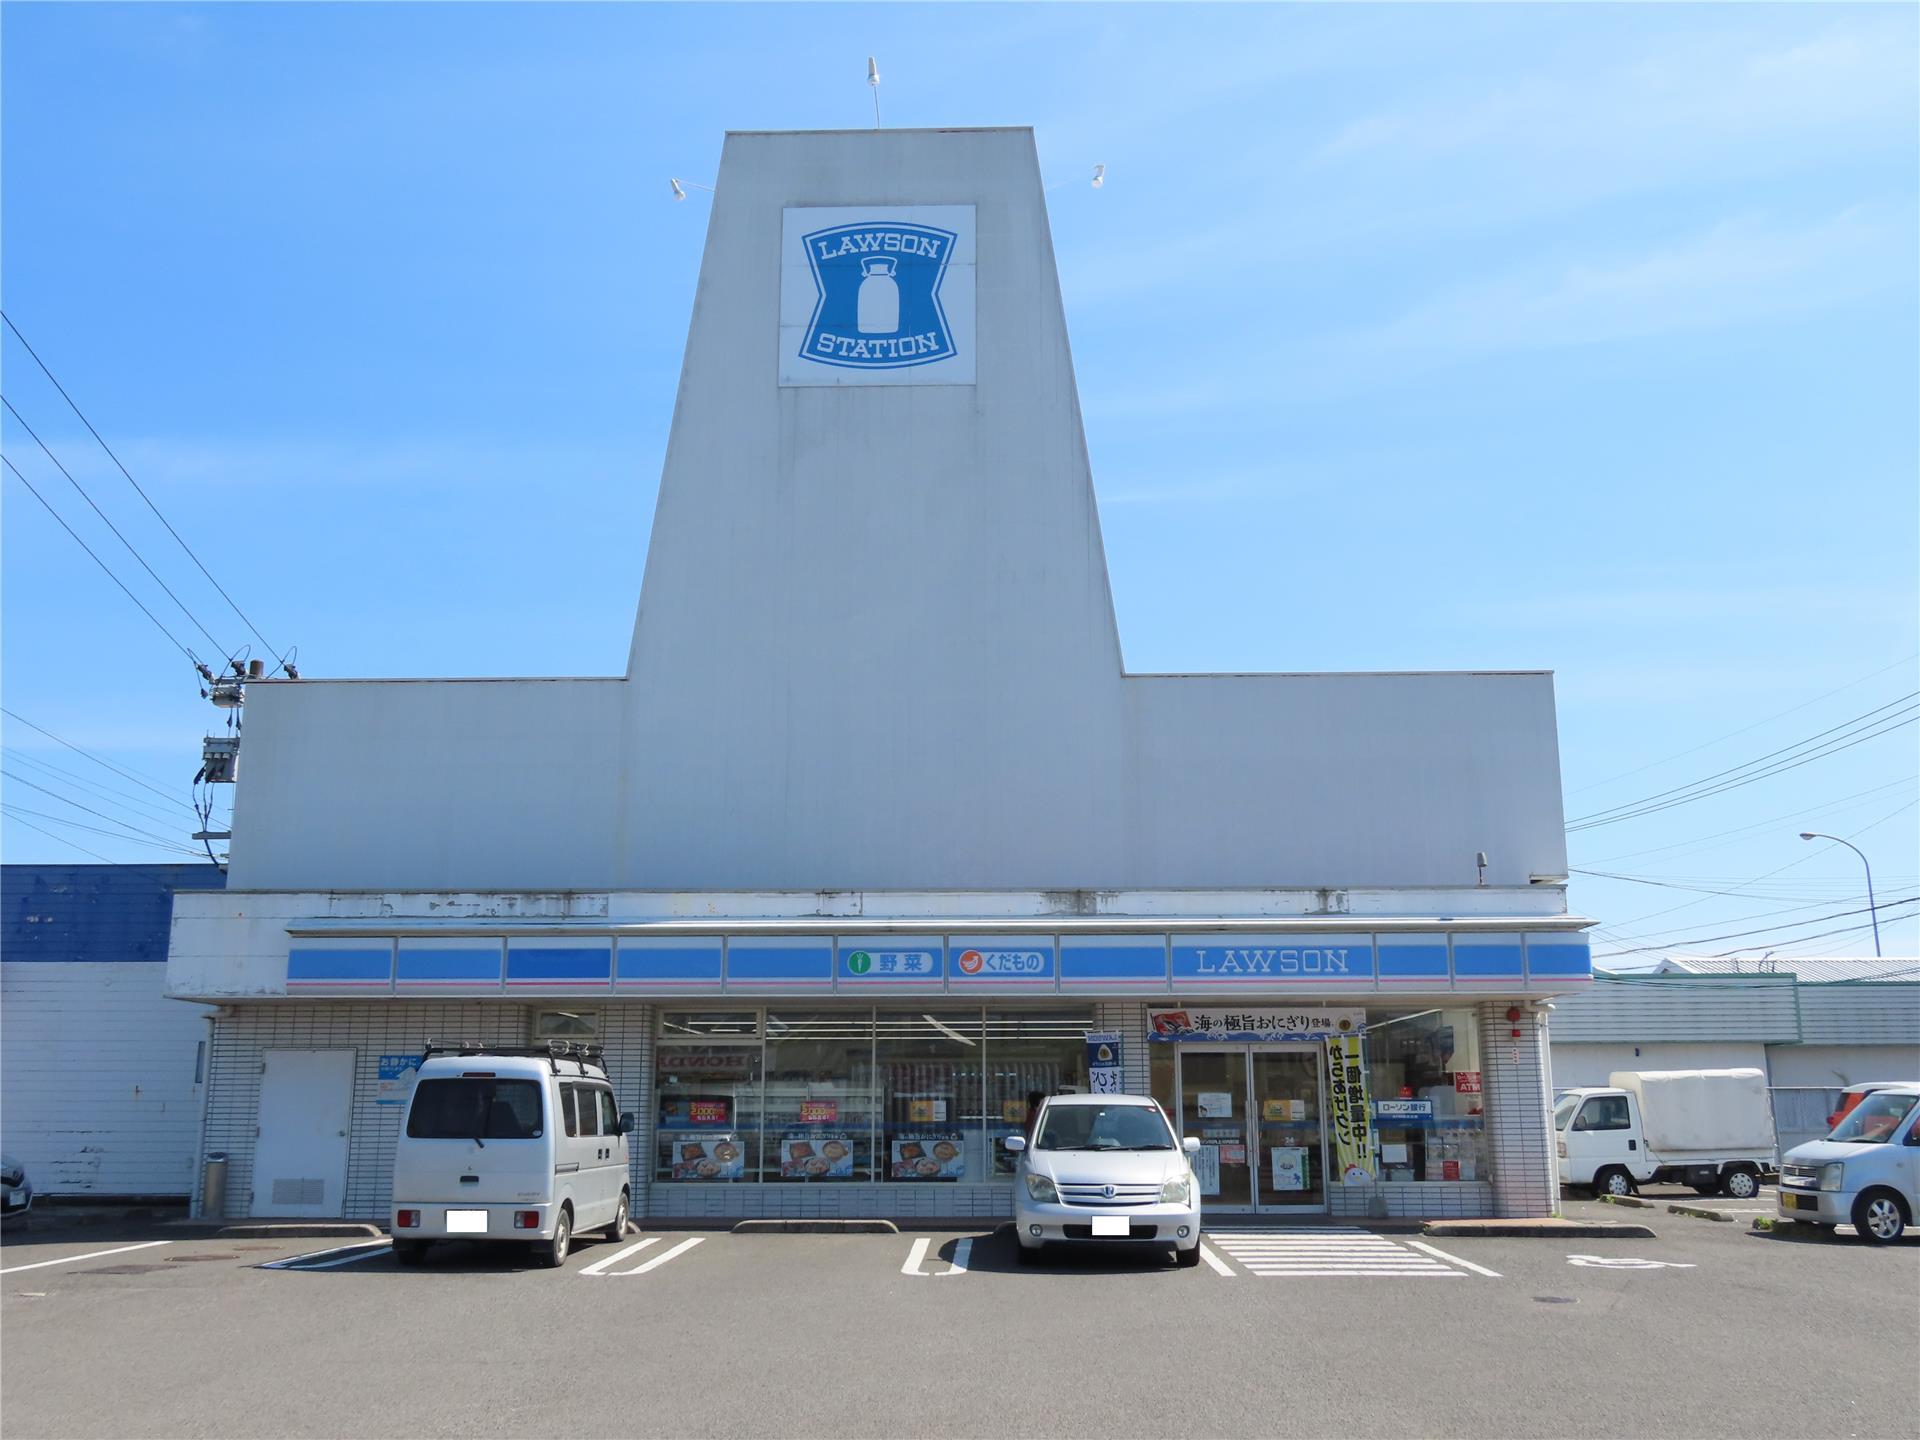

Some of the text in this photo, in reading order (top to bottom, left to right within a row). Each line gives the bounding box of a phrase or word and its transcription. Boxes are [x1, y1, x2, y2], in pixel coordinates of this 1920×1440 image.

[818, 232, 941, 260] LAWSON
[816, 331, 940, 359] STATION
[879, 953, 923, 972] 野菜
[985, 953, 1040, 974] くだもの
[1196, 949, 1348, 974] LAWSON
[1460, 1083, 1481, 1091] ATM
[1383, 1103, 1426, 1112] ローソン銀行
